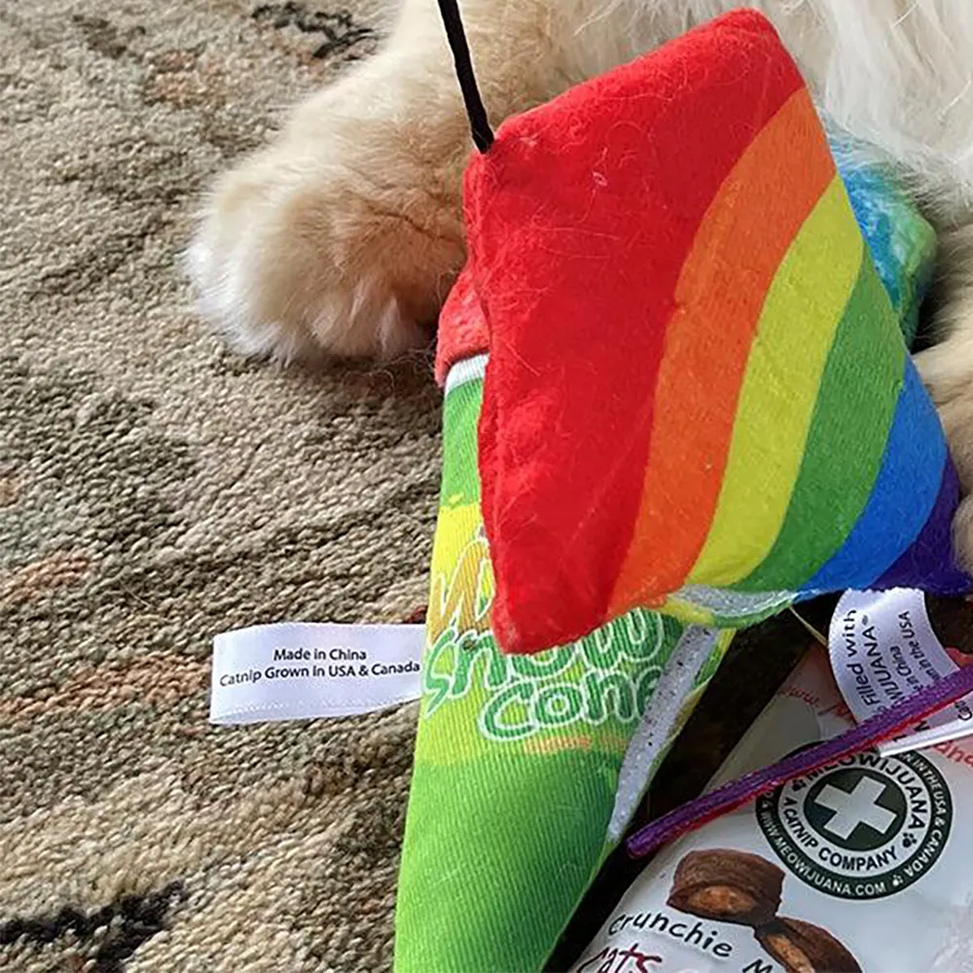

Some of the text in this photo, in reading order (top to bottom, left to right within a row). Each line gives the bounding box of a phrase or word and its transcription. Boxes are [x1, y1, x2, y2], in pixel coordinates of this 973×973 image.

[898, 611, 915, 639] USA
[273, 648, 367, 661] Made in China
[842, 610, 880, 705] Filled with
[890, 646, 912, 676] China
[908, 640, 925, 659] the
[219, 670, 262, 687] Catnip
[264, 666, 310, 679] Grown
[328, 665, 355, 677] USA
[358, 665, 369, 677] &
[371, 661, 421, 675] Canada
[922, 769, 942, 790] THE
[933, 792, 947, 815] USA
[783, 808, 819, 847] CATNIP
[818, 845, 898, 872] COMPANY
[904, 830, 943, 876] CANADA
